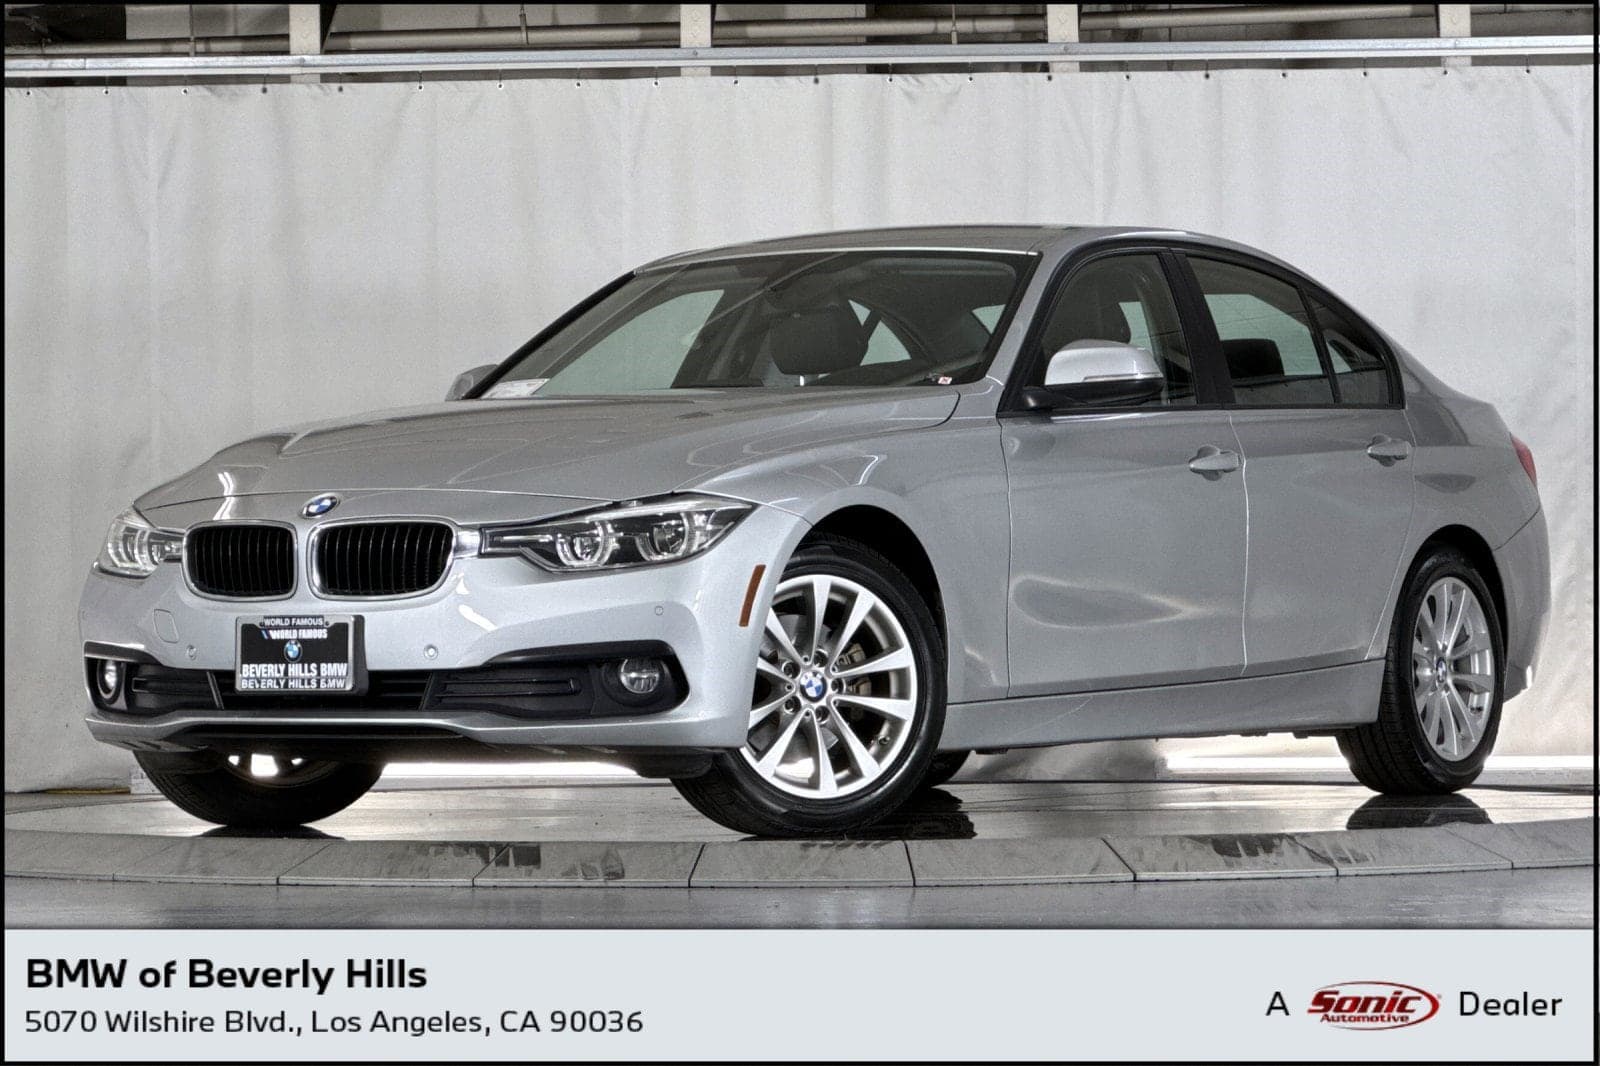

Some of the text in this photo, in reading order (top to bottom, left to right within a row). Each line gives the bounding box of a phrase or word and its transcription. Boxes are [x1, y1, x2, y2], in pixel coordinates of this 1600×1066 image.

[264, 617, 324, 626] WORLD FAMOUS
[269, 629, 328, 639] WORLD FAMOUS
[242, 663, 348, 677] BEVERLY HILLS BMW
[241, 678, 346, 689] BEVERLY HILLS BMW
